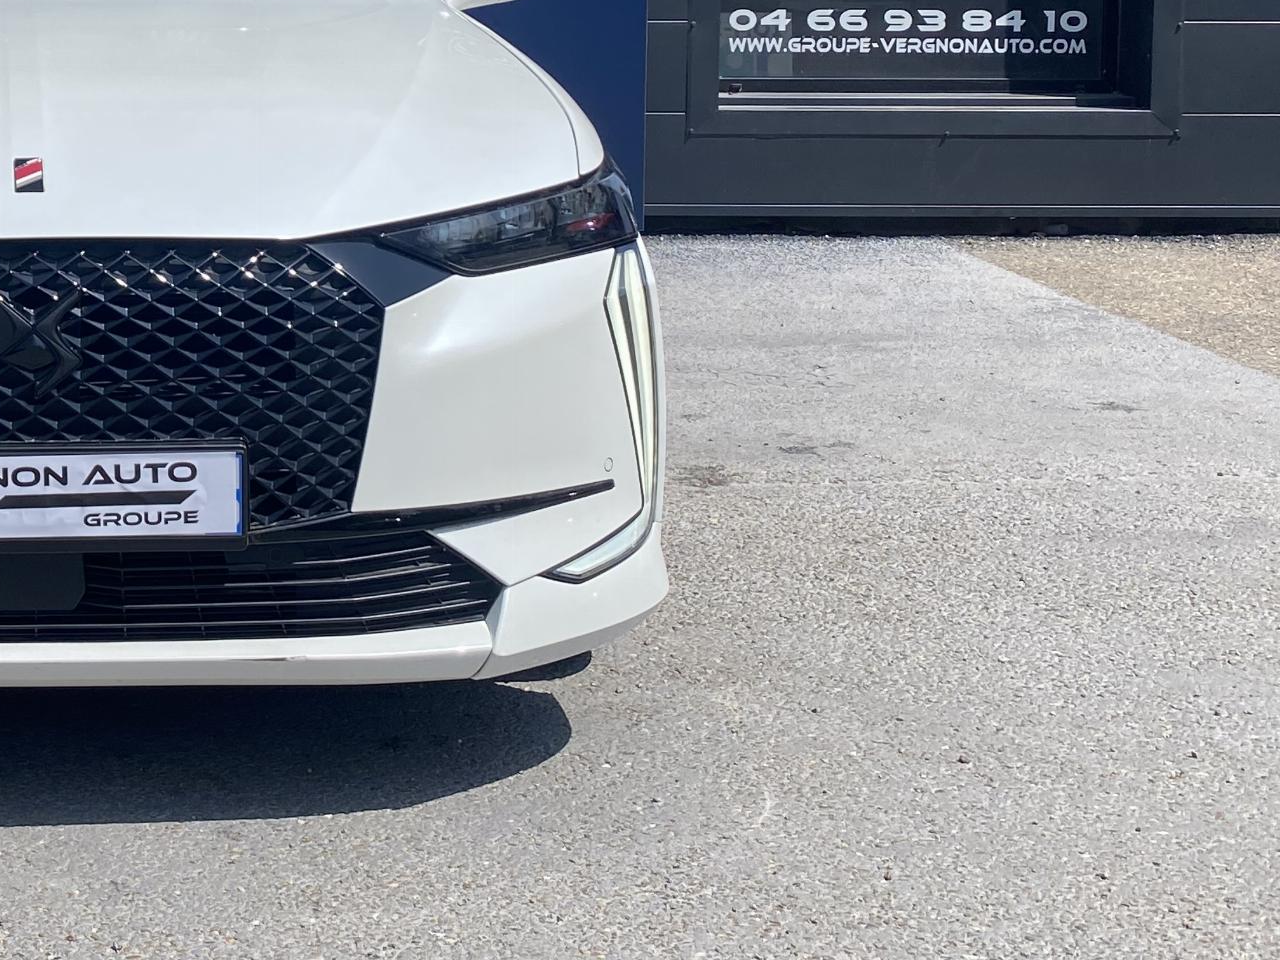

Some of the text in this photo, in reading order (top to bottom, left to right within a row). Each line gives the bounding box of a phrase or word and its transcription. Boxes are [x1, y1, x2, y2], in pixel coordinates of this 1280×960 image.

[729, 8, 1088, 33] 04 66 93 84 10
[729, 36, 1087, 55] WWW.GROUPE-VERGNONAUTO.COM
[82, 461, 198, 486] AUTO
[82, 510, 199, 527] GROUPE
